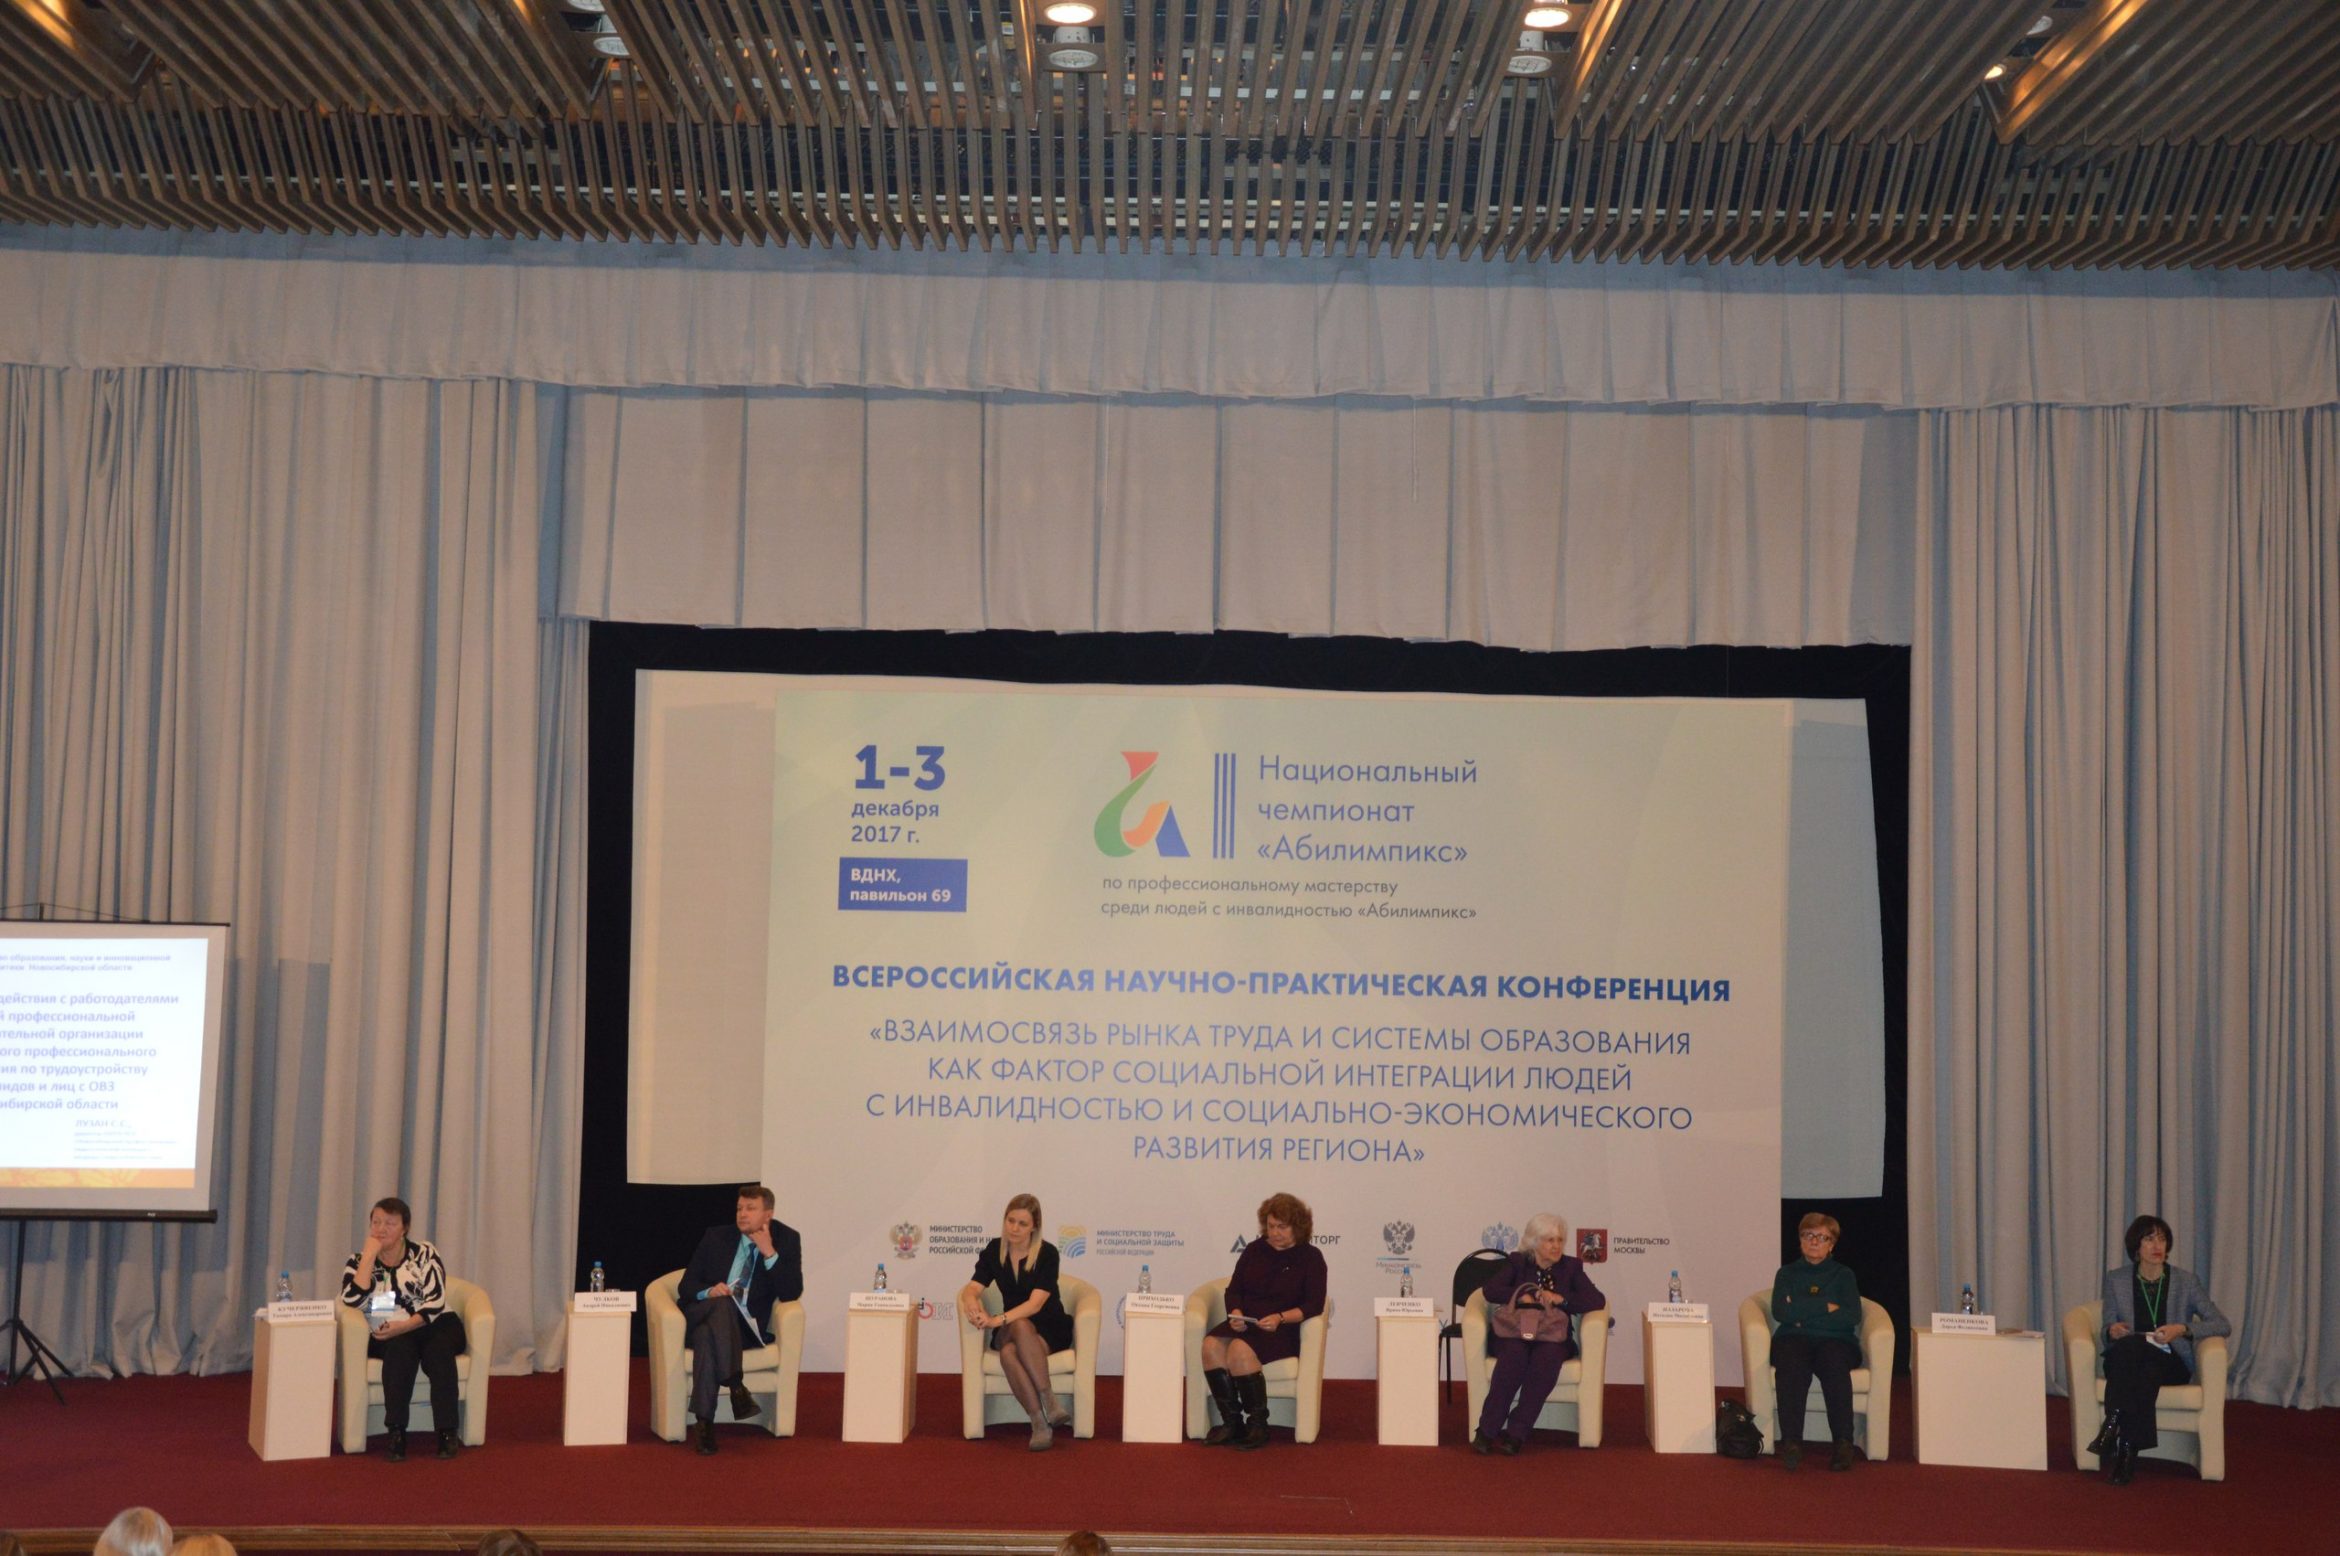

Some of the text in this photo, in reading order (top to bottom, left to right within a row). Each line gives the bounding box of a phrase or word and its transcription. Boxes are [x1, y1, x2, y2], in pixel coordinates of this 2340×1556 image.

[854, 745, 946, 793] 1-3
[1259, 754, 1478, 787] Национальный
[850, 800, 940, 823] декабря
[1258, 803, 1416, 825] чемпионат
[850, 825, 920, 845] 2017 г.
[1257, 833, 1469, 866] «Абилимпикс»
[850, 867, 902, 884] ВДНХ,
[849, 888, 952, 903] павильон 69
[1102, 875, 1400, 900] по профессиональному мастерству
[1100, 901, 1478, 921] среди людей с инвалидностью «Абилимпикс»
[832, 962, 1731, 1008] ВСЕРОССИЙСКАЯ НАУЧНО-ПРАКТИЧЕСКАЯ КОНФЕРЕНЦИЯ
[60, 994, 67, 1004] с
[70, 991, 179, 1007] работодателями
[8, 1010, 136, 1024] профессиональной
[58, 1029, 144, 1042] организации
[869, 1019, 1691, 1057] «ВЗАИМОСВЯЗЬ РЫНКА ТРУДА И СИСТЕМЫ ОБРАЗОВАНИЯ
[25, 1046, 158, 1060] профессионального
[21, 1065, 37, 1075] по
[41, 1063, 149, 1077] трудоустройству
[928, 1056, 1633, 1095] КАК ФАКТОР СОЦИАЛЬНОЙ ИНТЕГРАЦИИ ЛЮДЕЙ
[39, 1083, 47, 1092] и
[51, 1083, 76, 1094] лиц
[79, 1083, 85, 1092] с
[66, 1098, 119, 1110] области
[865, 1093, 1693, 1132] С ИНВАЛИДНОСТЬЮ И СОЦИАЛЬНО-ЭКОНОМИЧЕСКОГО
[1133, 1136, 1425, 1164] РАЗВИТИЯ РЕГИОНА»
[929, 1225, 983, 1233] МИНИСТЕРСТВО
[1096, 1230, 1176, 1239] МИНИСТЕРСТВО ТРУДА
[929, 1235, 978, 1244] ОБРАЗОВАНИЯ
[1103, 1237, 1152, 1247] СОЦИАЛЬНОЙ
[1153, 1239, 1185, 1247] ЗАЩИТЫ
[1613, 1236, 1671, 1246] ПРАВИТЕЛЬСТВО
[928, 1245, 974, 1255] РОССИЙСКОЙ
[1613, 1246, 1646, 1255] МОСКВЫ
